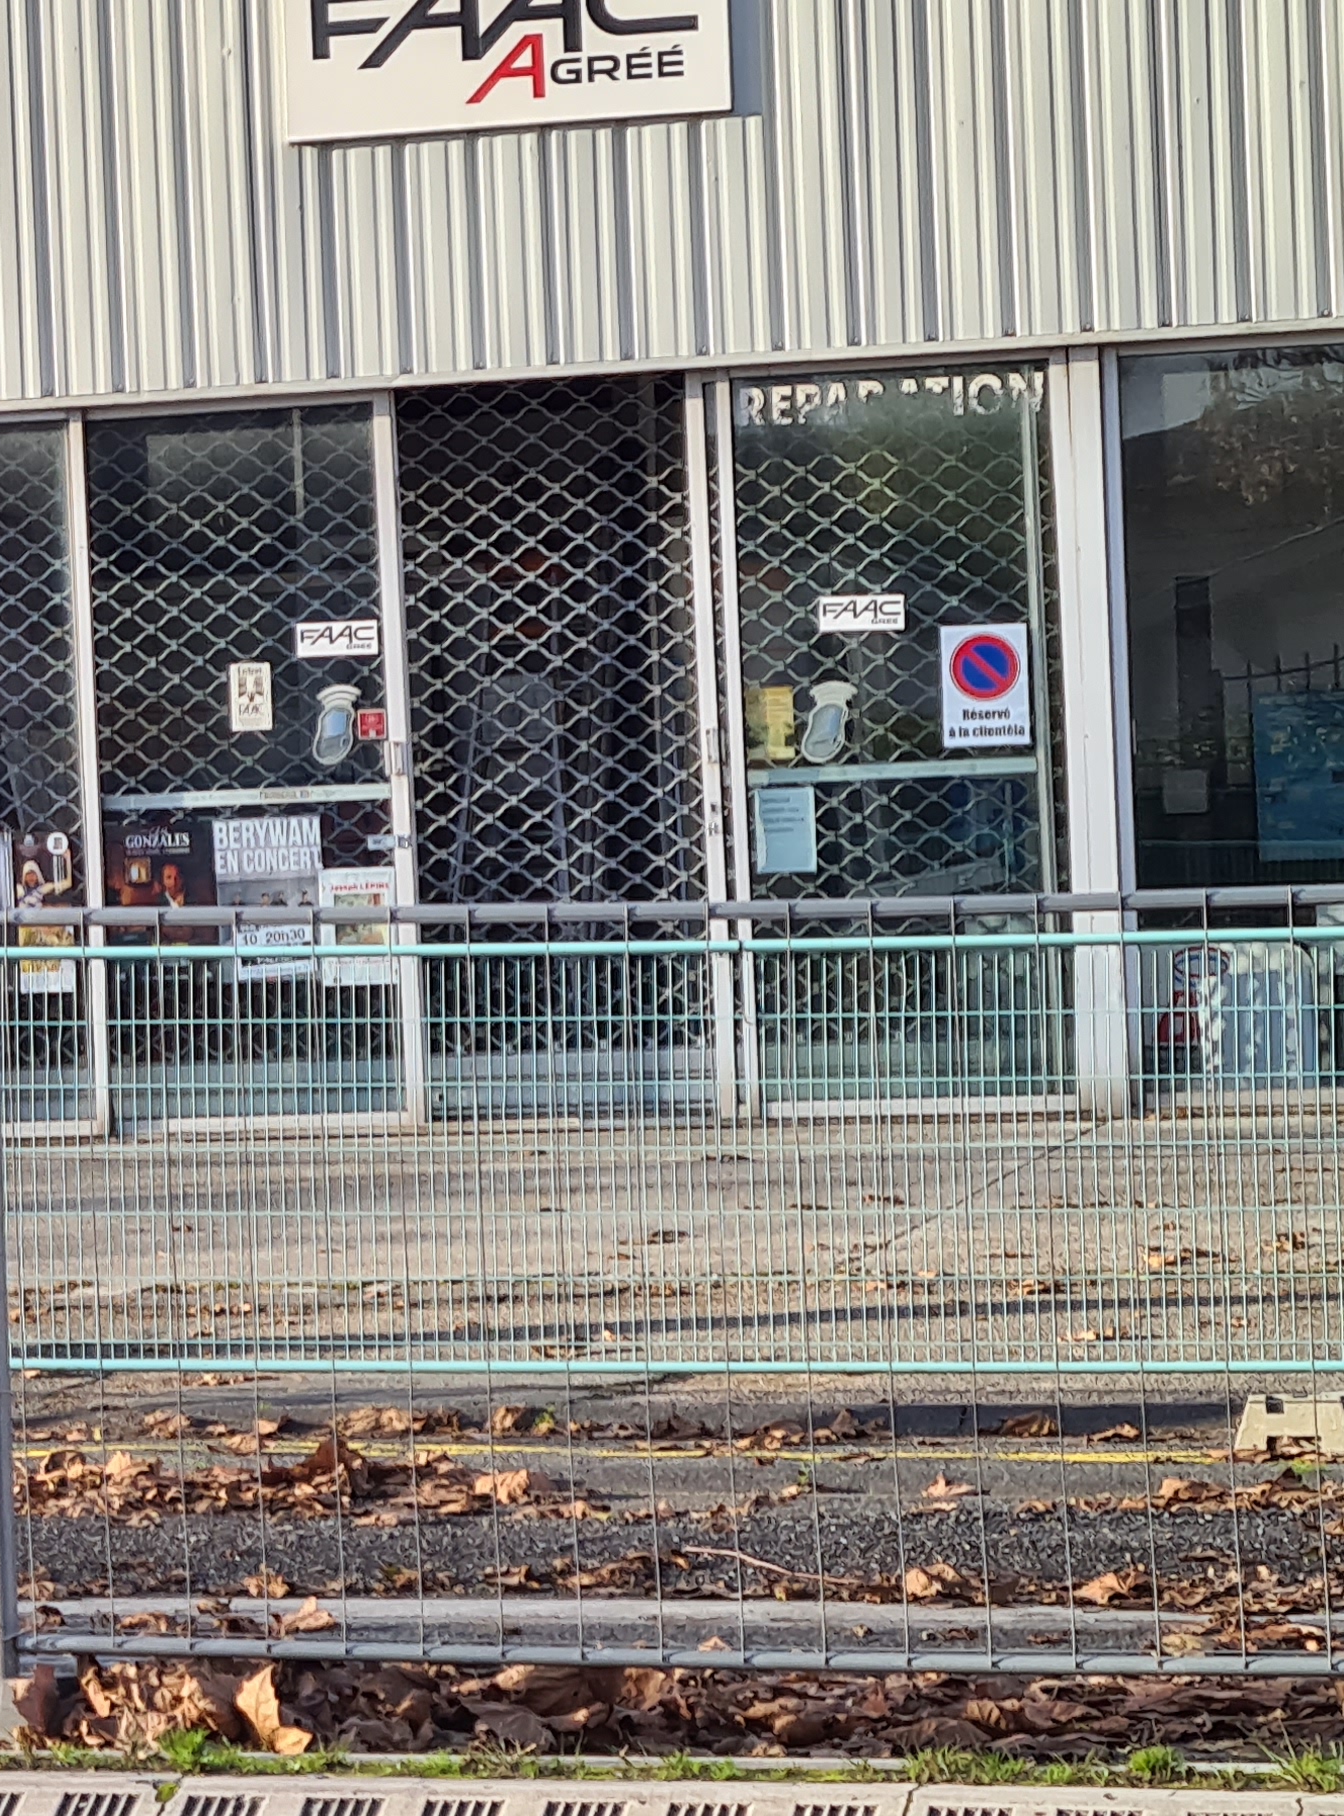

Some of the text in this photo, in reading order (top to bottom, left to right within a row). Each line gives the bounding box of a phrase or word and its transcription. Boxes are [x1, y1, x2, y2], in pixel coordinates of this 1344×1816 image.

[822, 599, 902, 621] FAAC
[300, 625, 375, 645] FAAC
[962, 708, 1011, 721] Réservé
[948, 722, 1026, 739] à la clientèle
[214, 816, 321, 850] BERYWAM
[216, 849, 240, 876] EN
[265, 928, 306, 943] 20h30
